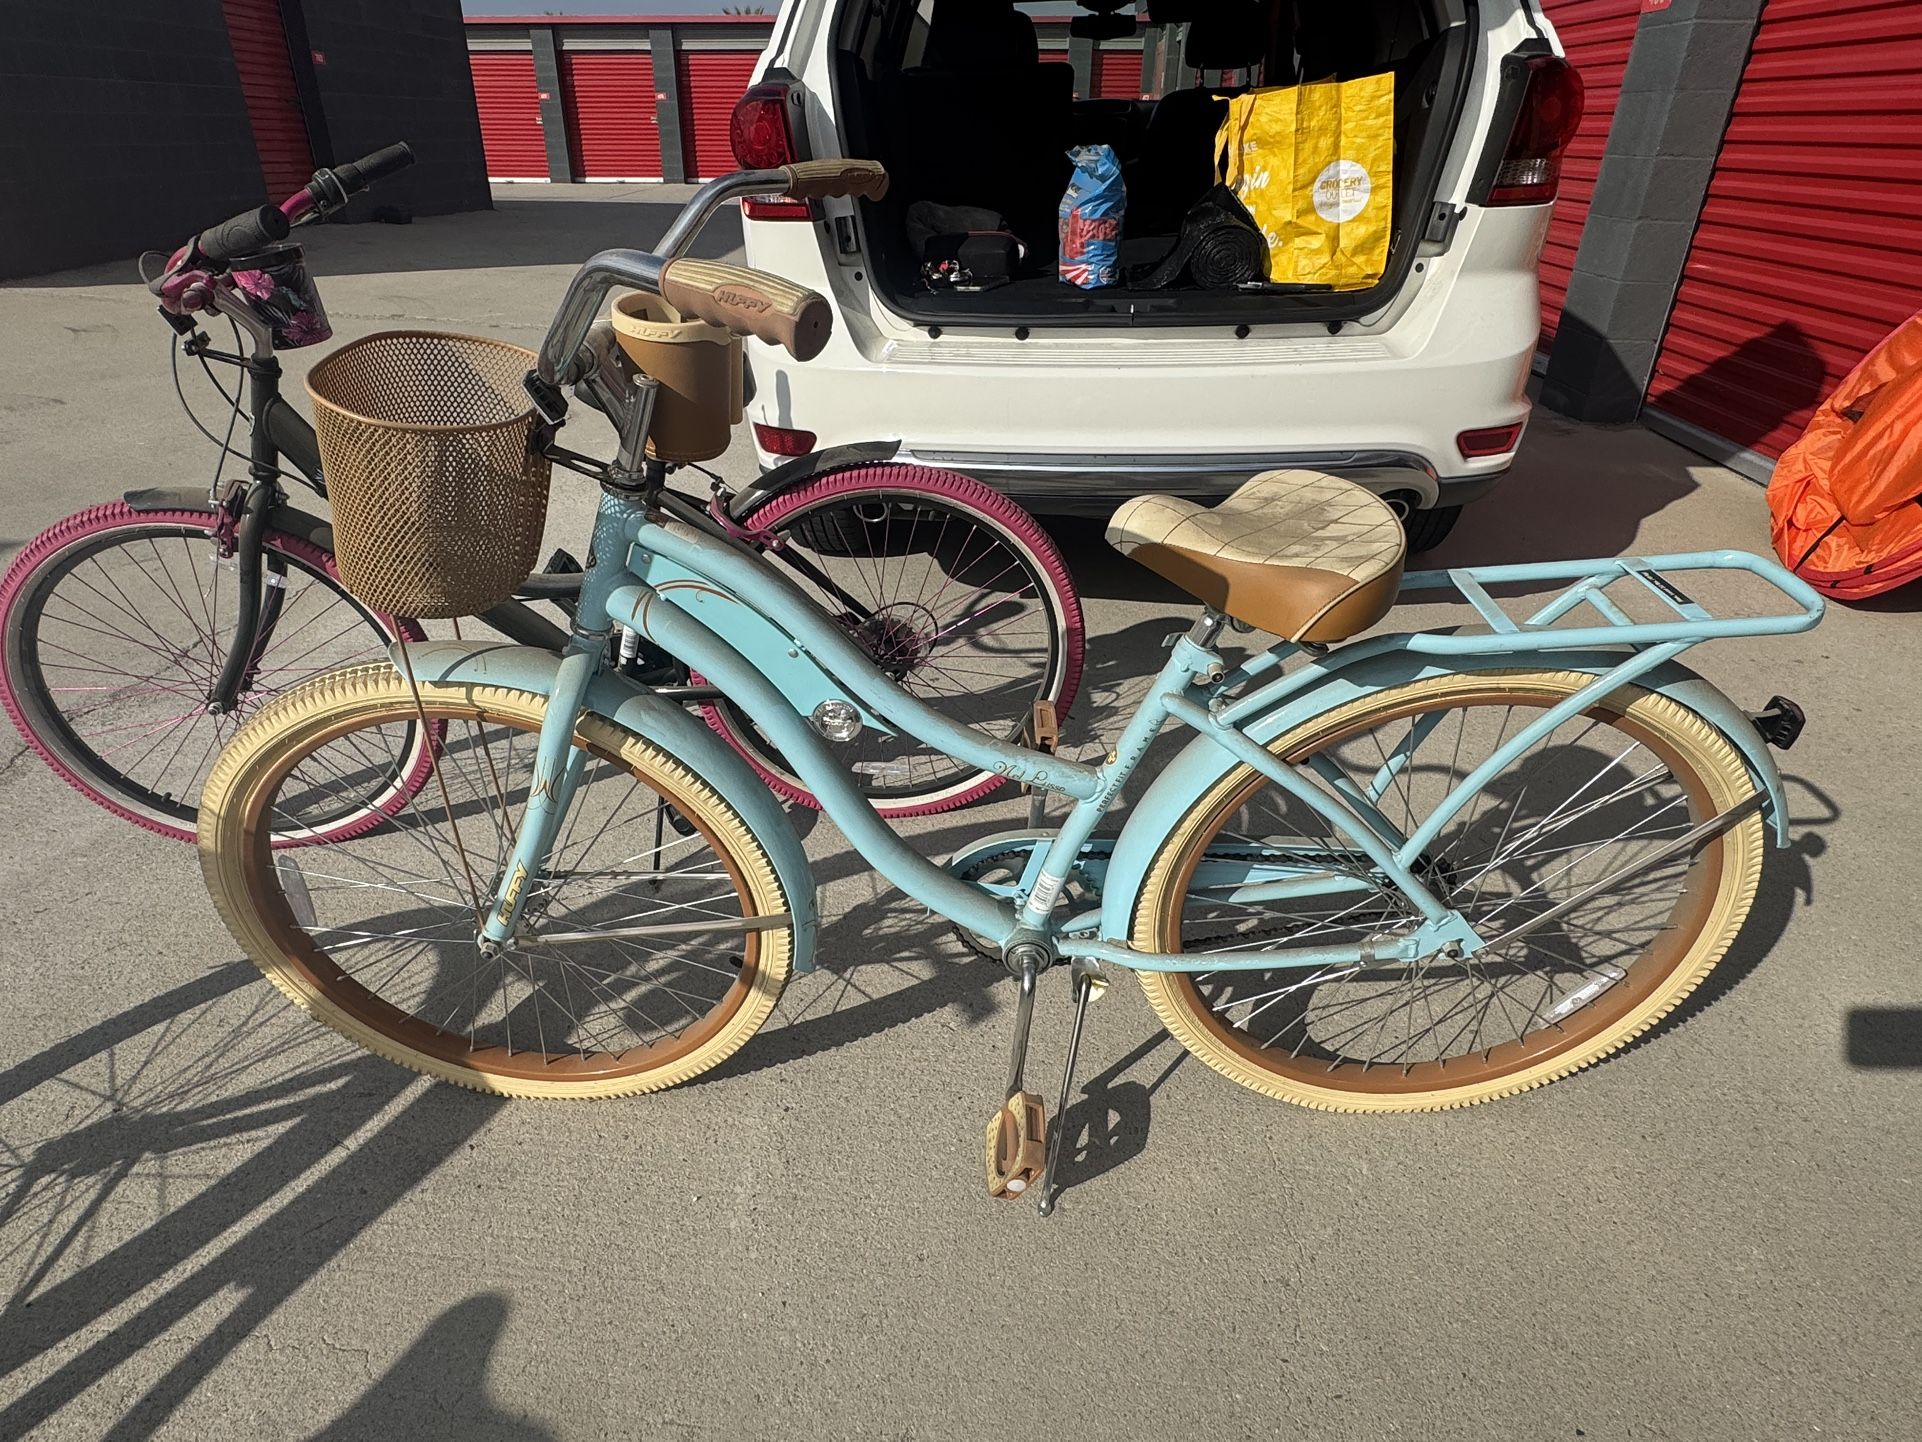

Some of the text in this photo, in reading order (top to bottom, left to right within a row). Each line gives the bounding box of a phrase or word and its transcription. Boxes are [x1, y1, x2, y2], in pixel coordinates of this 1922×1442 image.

[1320, 176, 1363, 190] GROCERY
[1325, 189, 1356, 200] OUTLET
[719, 290, 773, 314] HUFFY
[497, 858, 529, 927] HUFFY
